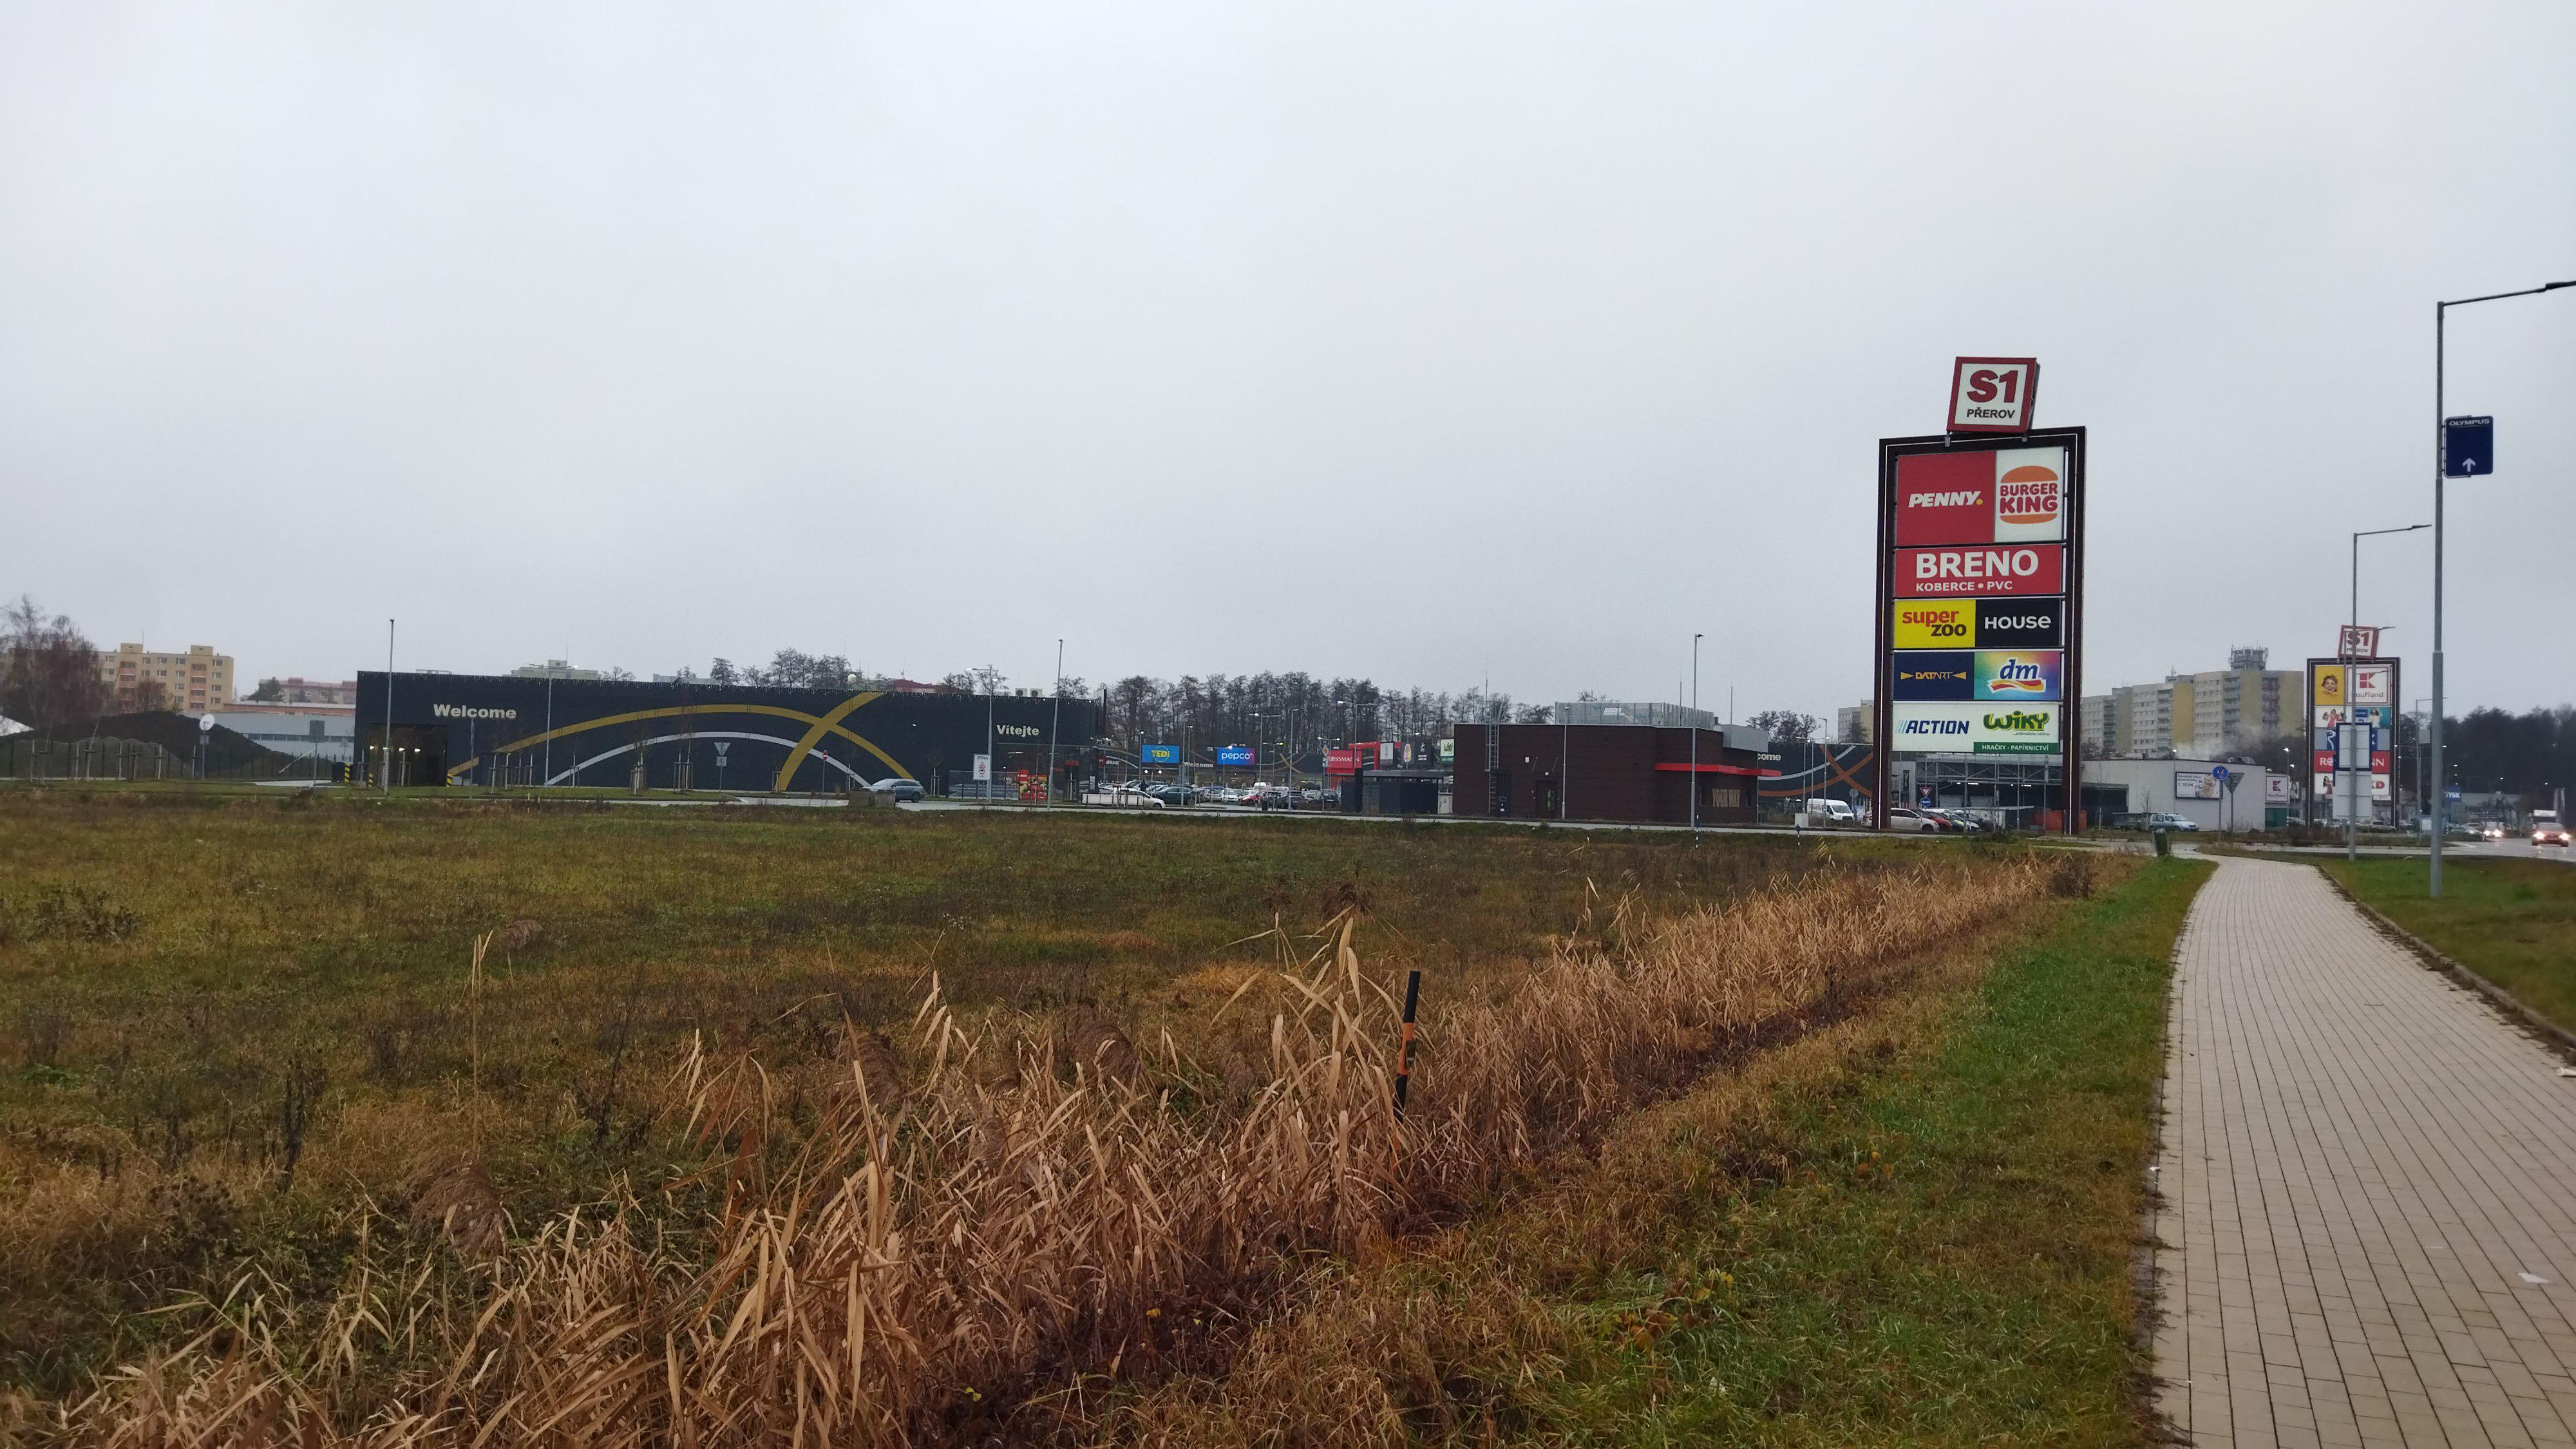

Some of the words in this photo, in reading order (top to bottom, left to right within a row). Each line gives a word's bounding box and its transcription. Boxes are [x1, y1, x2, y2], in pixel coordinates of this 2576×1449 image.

[1966, 369, 2018, 403] S1
[1966, 407, 2016, 419] PŘEROV
[2000, 482, 2058, 497] BURGER
[2000, 495, 2058, 514] KING
[1916, 549, 2039, 579] BRENO
[1916, 582, 1975, 592] KOBERCE
[1987, 581, 2013, 591] PVC
[1902, 611, 1960, 627] super
[2347, 630, 2370, 647] S1
[1915, 672, 1953, 680] DATART
[2000, 659, 2038, 680] dm
[433, 703, 516, 719] Welcome
[1905, 720, 1970, 734] ACTION
